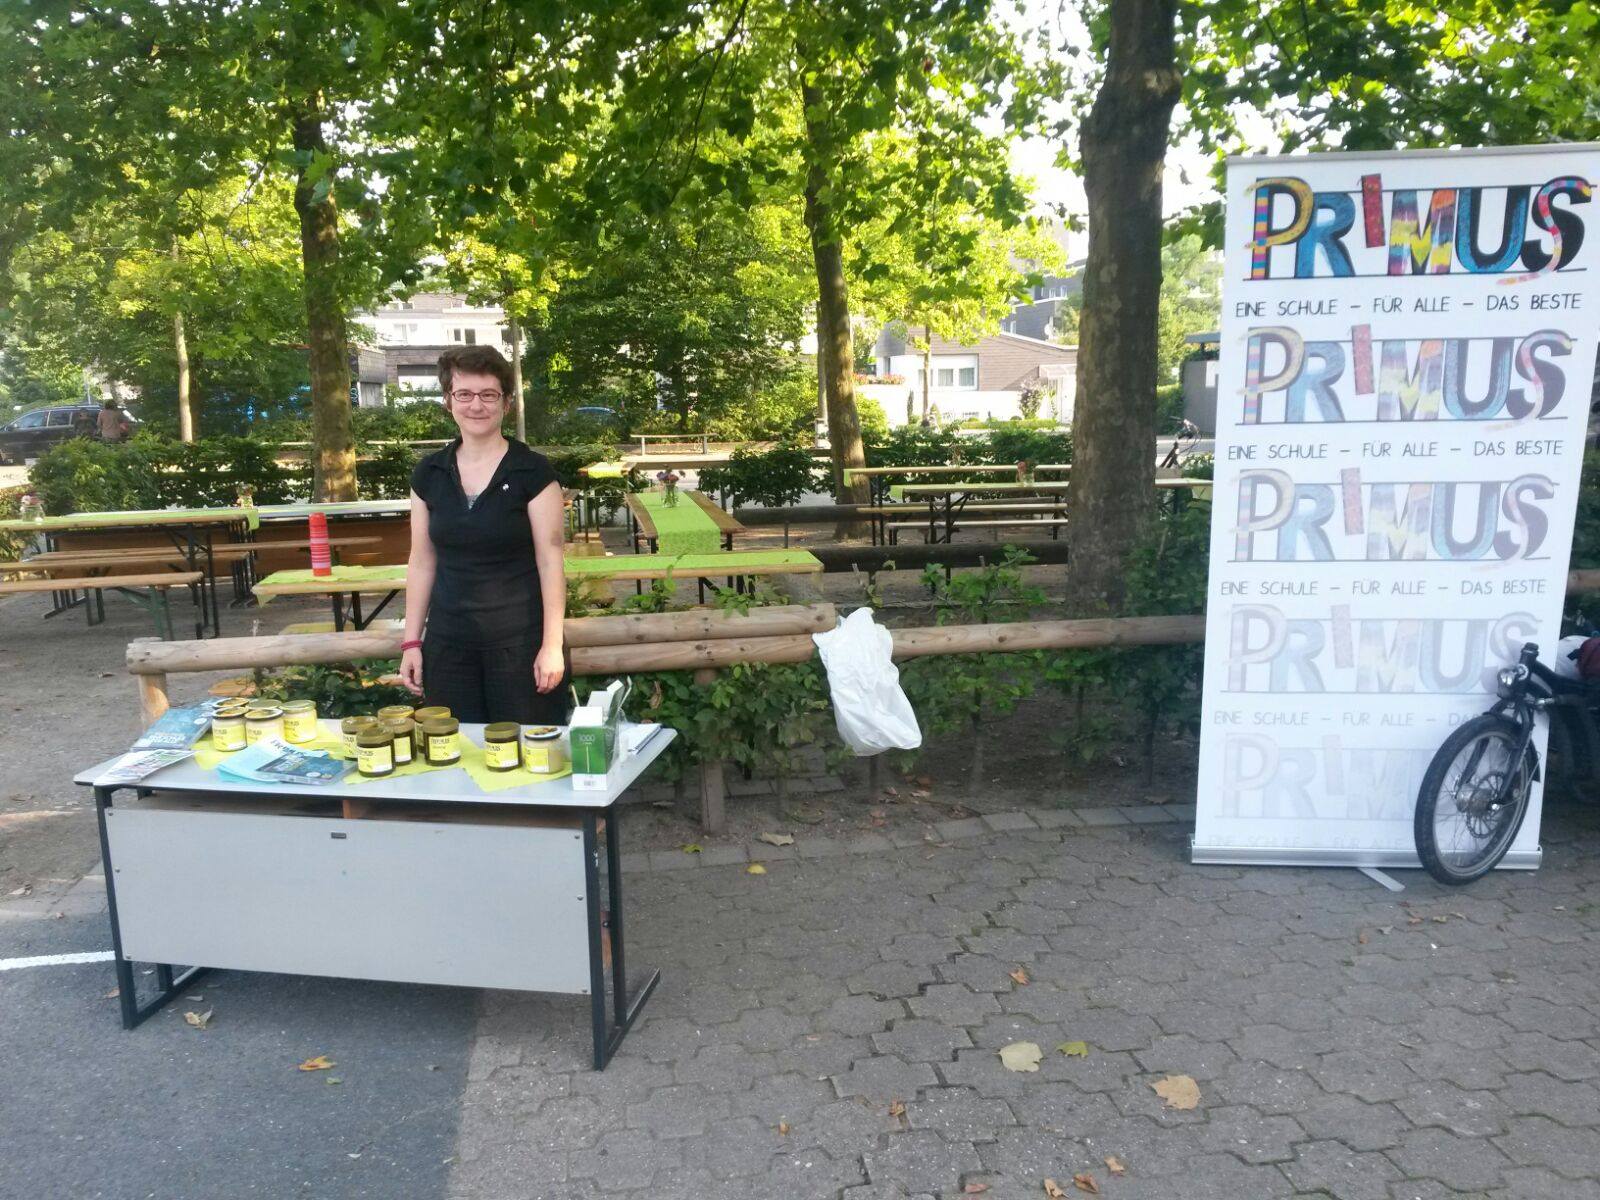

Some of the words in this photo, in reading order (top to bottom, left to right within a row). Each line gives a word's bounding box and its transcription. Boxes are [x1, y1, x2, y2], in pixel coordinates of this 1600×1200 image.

[1243, 173, 1592, 284] PRIMUS
[1236, 302, 1266, 317] EINE
[1277, 299, 1337, 316] SCHULE
[1374, 297, 1402, 313] FÜR
[1414, 296, 1450, 312] ALLE
[1487, 295, 1519, 311] DAS
[1531, 293, 1582, 309] BESTE
[1236, 324, 1573, 430] PRIMUS
[1228, 445, 1257, 460] EINE
[1268, 444, 1327, 458] SCHULE
[1363, 441, 1391, 457] FÜR
[1402, 442, 1438, 456] ALLE
[1474, 441, 1505, 456] DAS
[1516, 440, 1563, 455] BESTE
[1230, 468, 1555, 570] PRIMUS
[1221, 581, 1248, 595] EINE
[1260, 581, 1318, 595] SCHULE
[1353, 580, 1380, 595] FÜR
[1391, 580, 1426, 595] ALLE
[1461, 580, 1492, 595] DAS
[1503, 579, 1546, 594] BESTE
[1214, 711, 1241, 724] EINE
[1254, 712, 1309, 726] SCHULE
[1343, 712, 1370, 726] FÜR
[1381, 713, 1414, 728] ALLE
